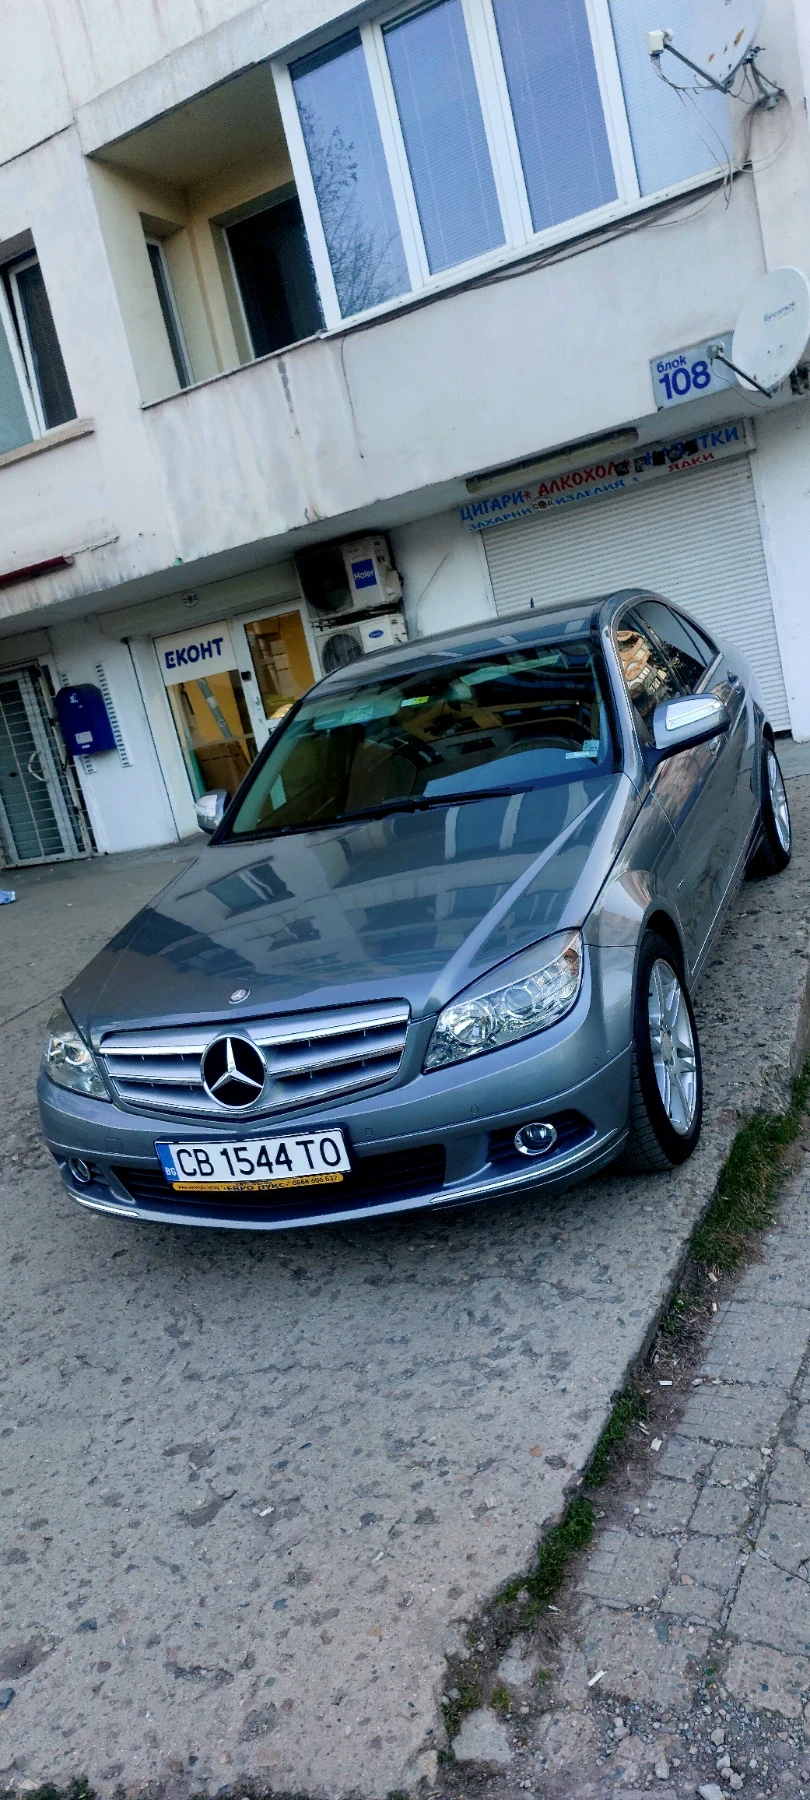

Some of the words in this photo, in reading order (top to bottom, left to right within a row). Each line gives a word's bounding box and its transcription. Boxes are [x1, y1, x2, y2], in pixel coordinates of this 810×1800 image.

[657, 355, 688, 374] блок
[659, 361, 712, 400] 108
[460, 490, 525, 521] ЦИГАРИ
[538, 461, 617, 496] АЛКОХОЛ
[468, 508, 533, 531] ЗАХАРНИ
[555, 480, 626, 505] ИЗДЕЛИЯ
[668, 453, 715, 472] ЯДКИ
[353, 569, 375, 581] Haier
[164, 637, 224, 669] ЕКОНТ
[165, 1167, 177, 1176] BG
[176, 1148, 215, 1177] CB
[220, 1142, 293, 1176] 1544
[296, 1137, 342, 1169] TO
